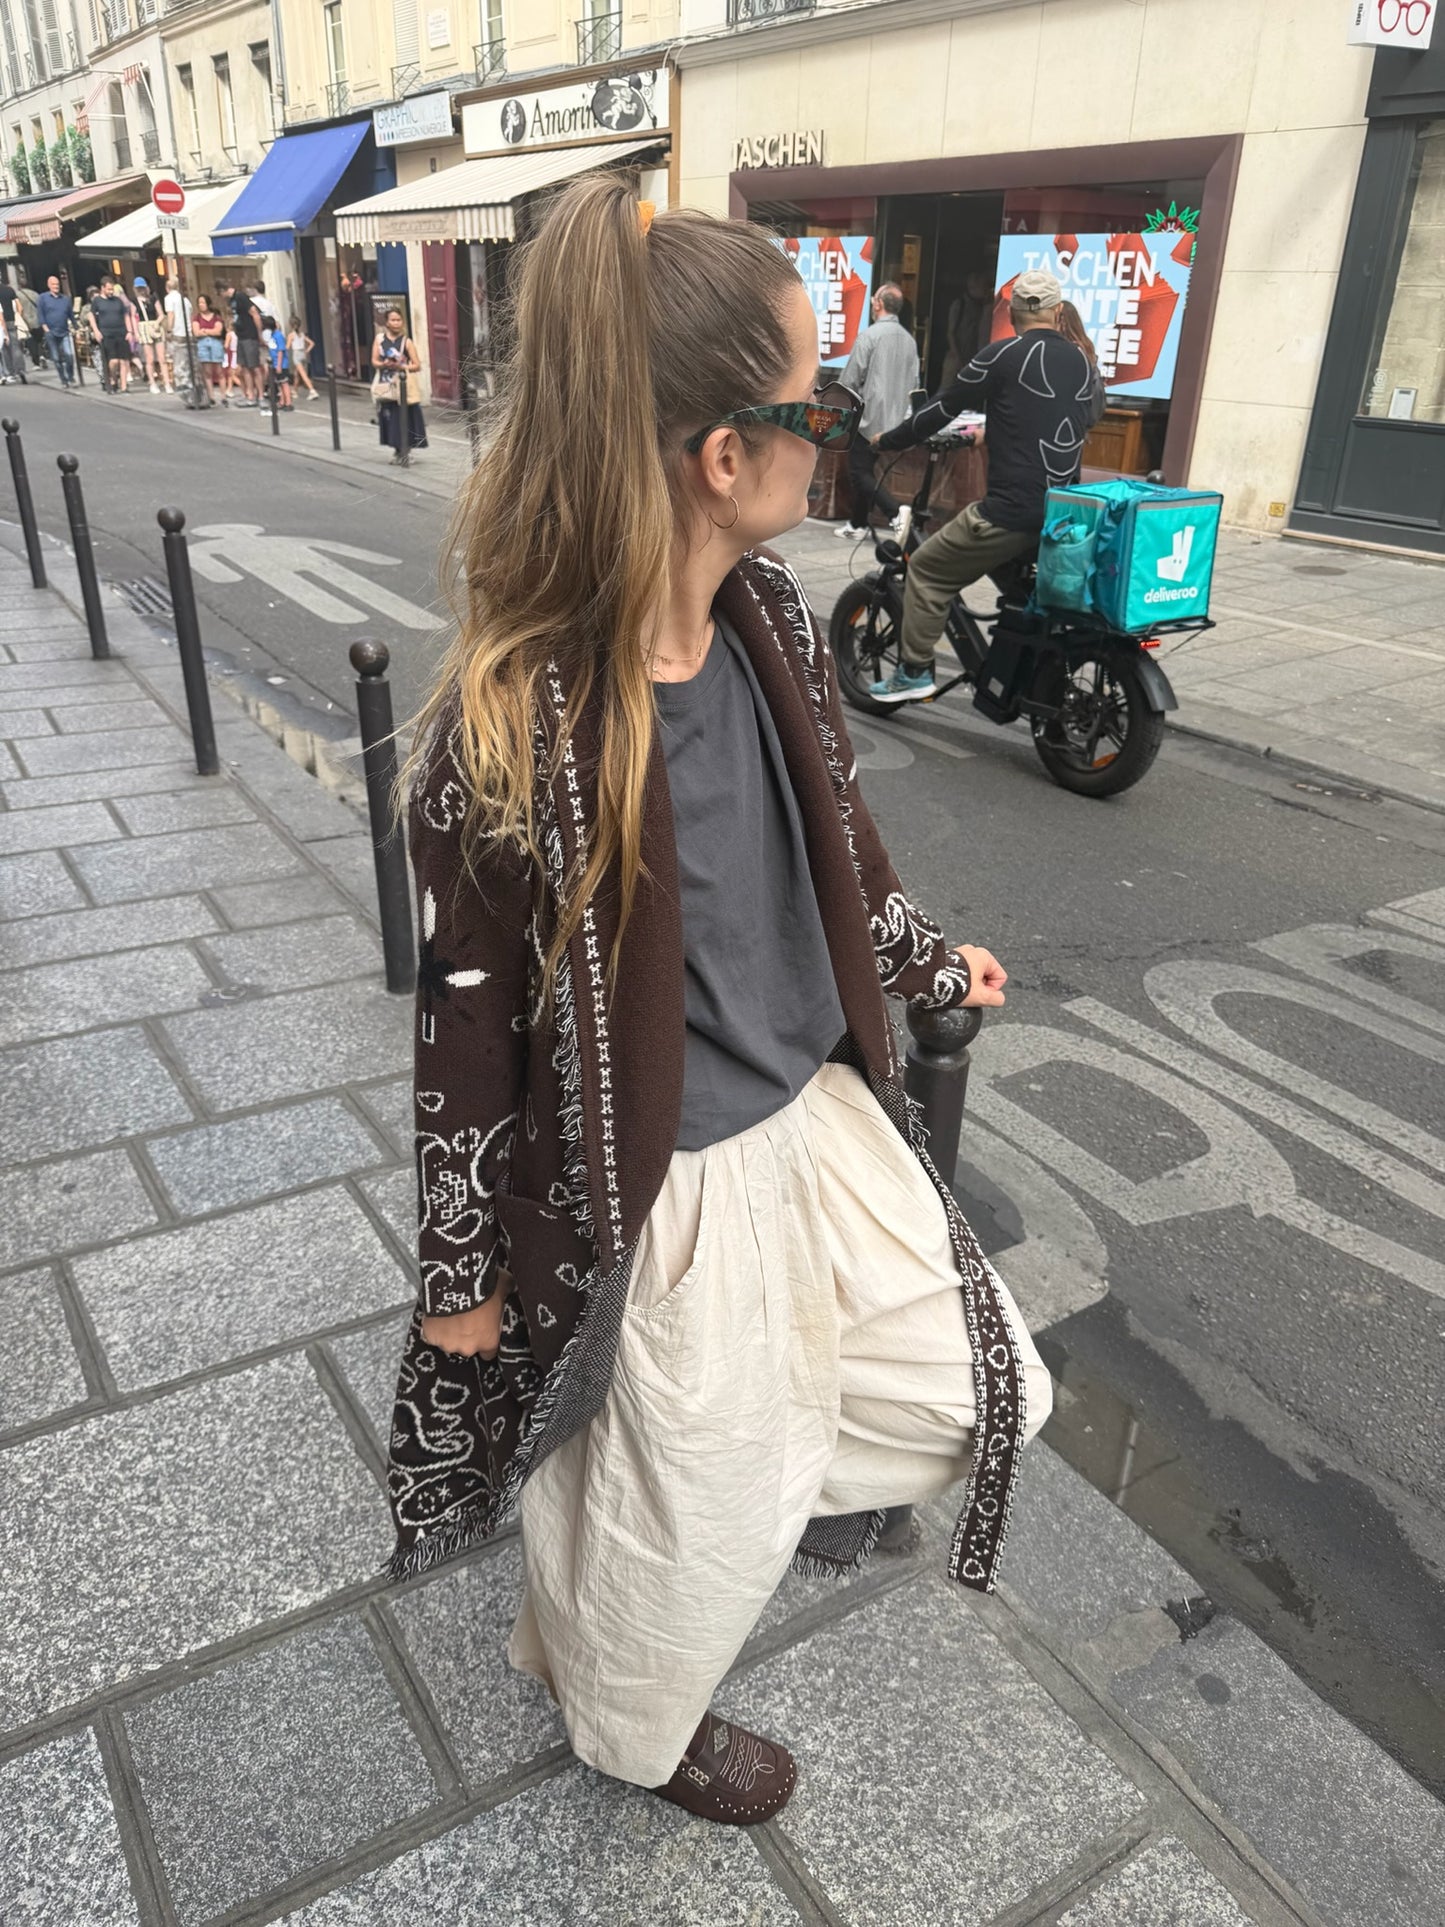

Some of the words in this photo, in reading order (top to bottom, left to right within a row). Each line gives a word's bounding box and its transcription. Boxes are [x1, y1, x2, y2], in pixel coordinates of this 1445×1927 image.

[530, 93, 600, 139] Amorin
[731, 130, 824, 171] TASCHEN
[788, 250, 853, 281] CHEN
[1144, 586, 1199, 604] deliveroo
